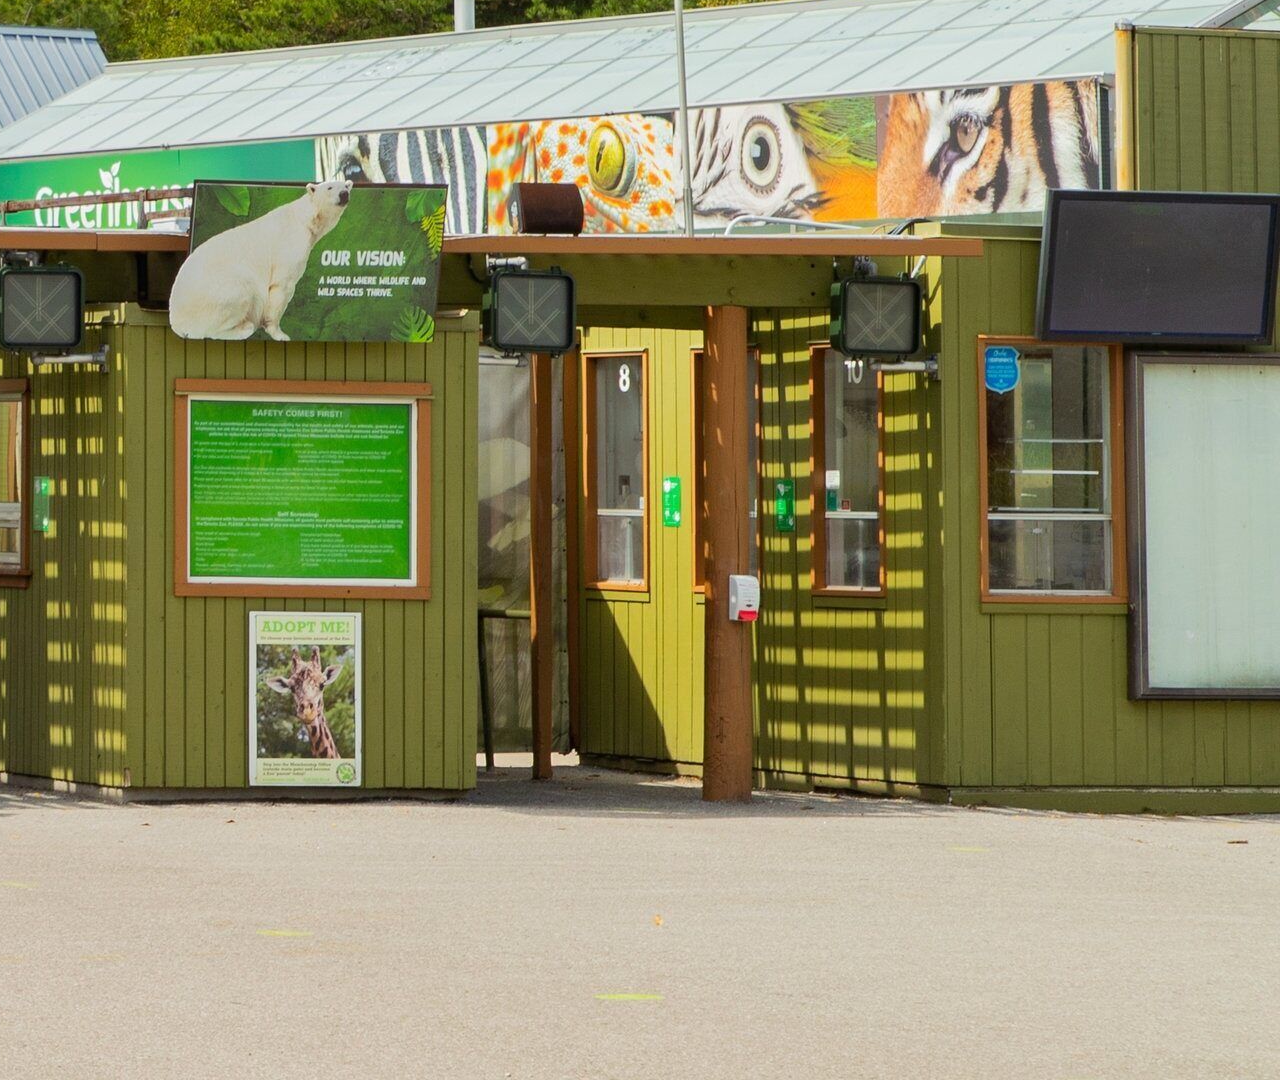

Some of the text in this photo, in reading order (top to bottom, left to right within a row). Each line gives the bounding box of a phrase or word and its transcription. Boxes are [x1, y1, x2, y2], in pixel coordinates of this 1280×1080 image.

[321, 250, 406, 267] OUR VISION:
[319, 276, 427, 285] A WORLD WHERE WILDLIFE AND
[317, 288, 335, 297] WILD
[336, 288, 364, 297] SPACES
[618, 363, 631, 393] 8
[844, 360, 864, 385] 10
[252, 409, 343, 418] SAFETY COMES FIRST!
[262, 620, 350, 634] ADOPT ME!
